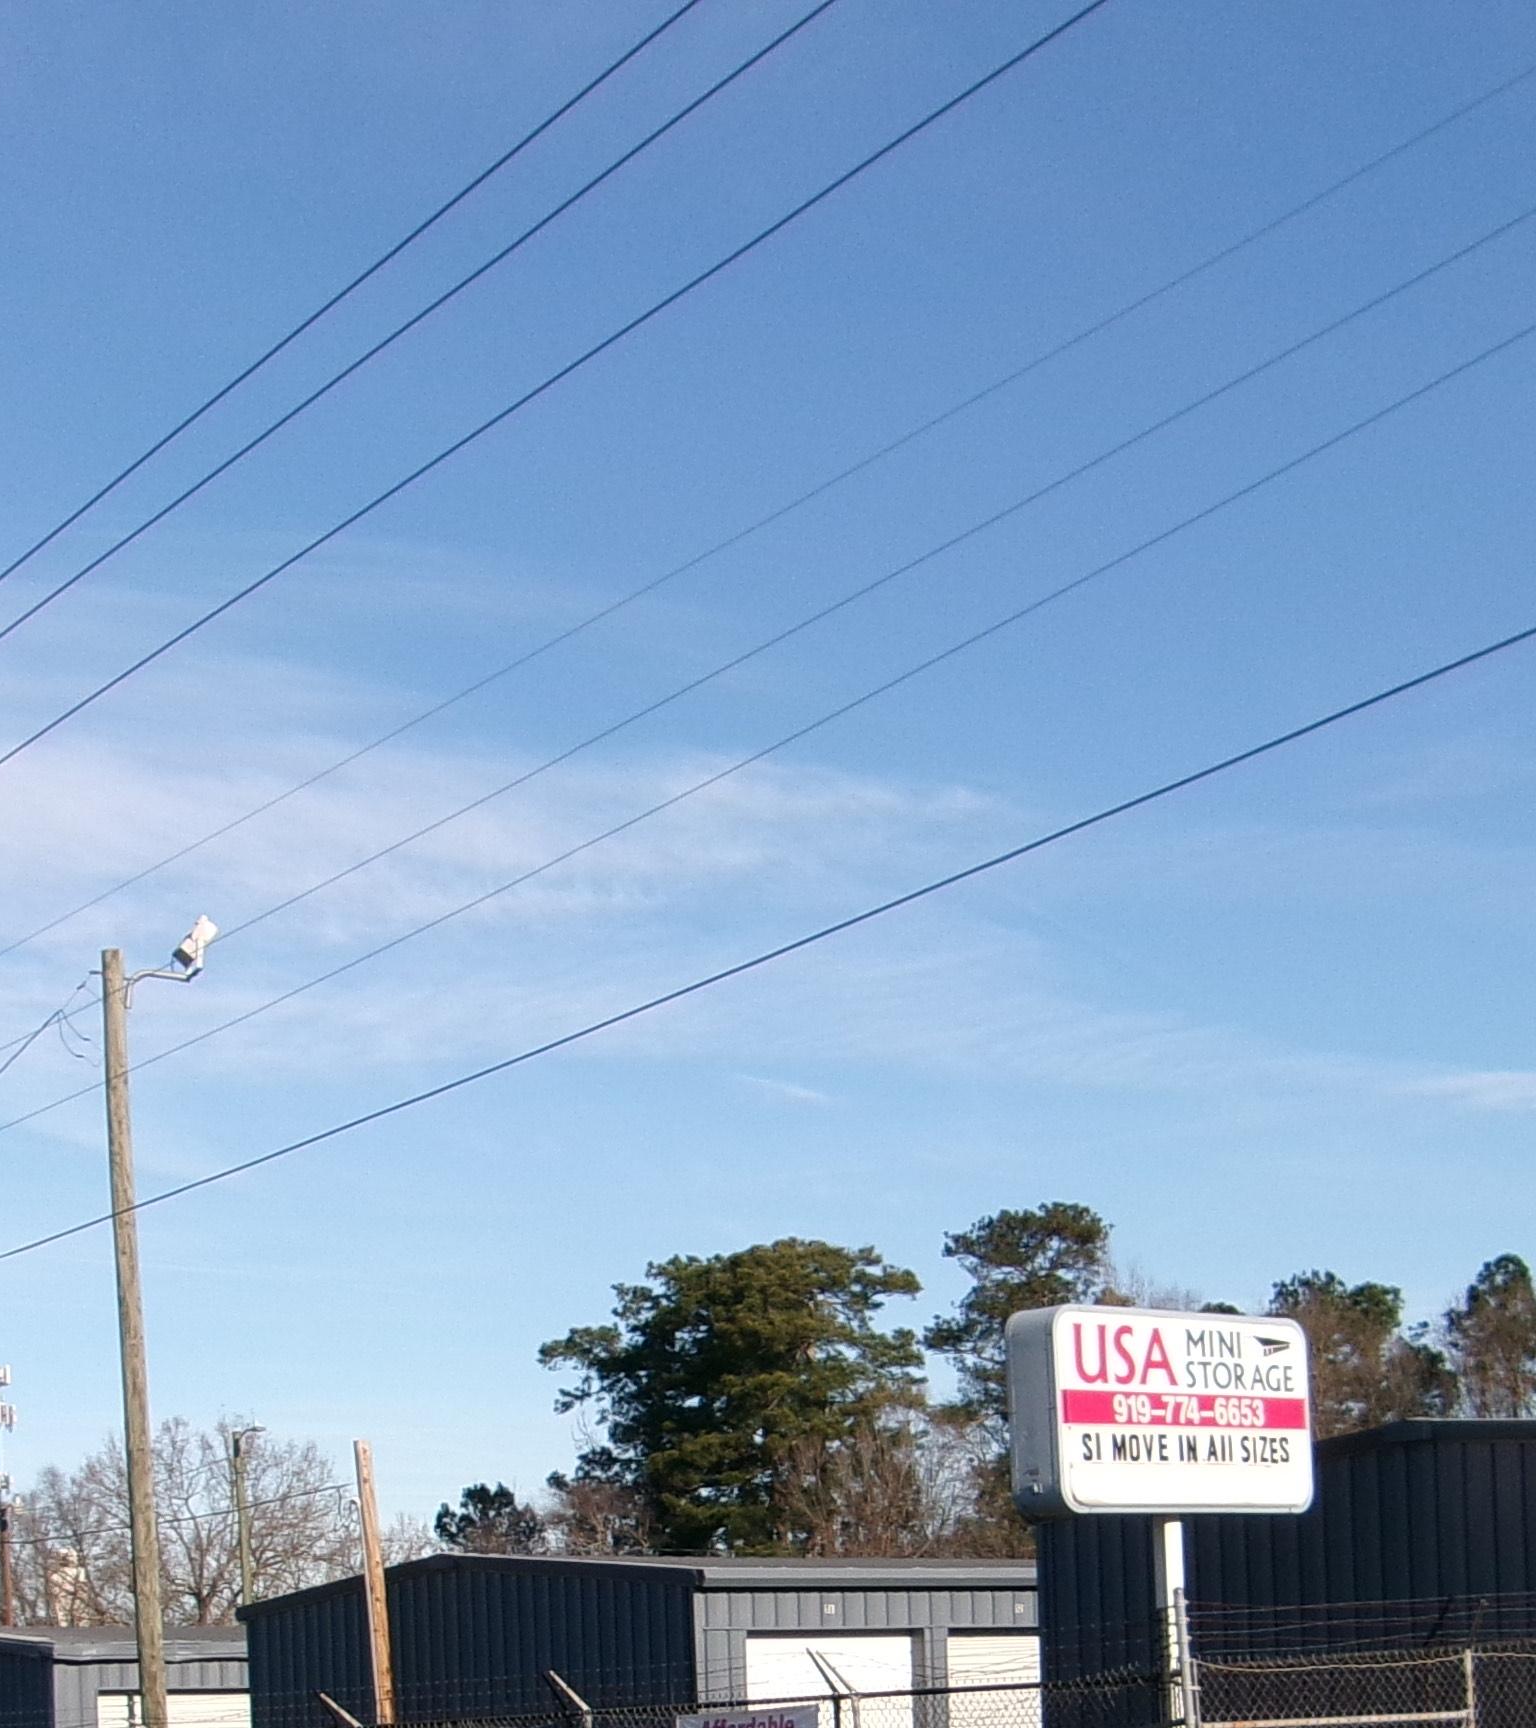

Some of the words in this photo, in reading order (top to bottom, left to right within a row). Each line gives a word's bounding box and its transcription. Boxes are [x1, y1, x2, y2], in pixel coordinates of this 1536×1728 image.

[1073, 1322, 1179, 1387] USA
[1185, 1329, 1242, 1358] MINI
[1185, 1361, 1295, 1393] STORAGE
[1112, 1393, 1265, 1427] 919-774-6653
[1111, 1433, 1169, 1463] MOVE
[1178, 1434, 1199, 1463] IN
[1240, 1435, 1291, 1465] SIZES
